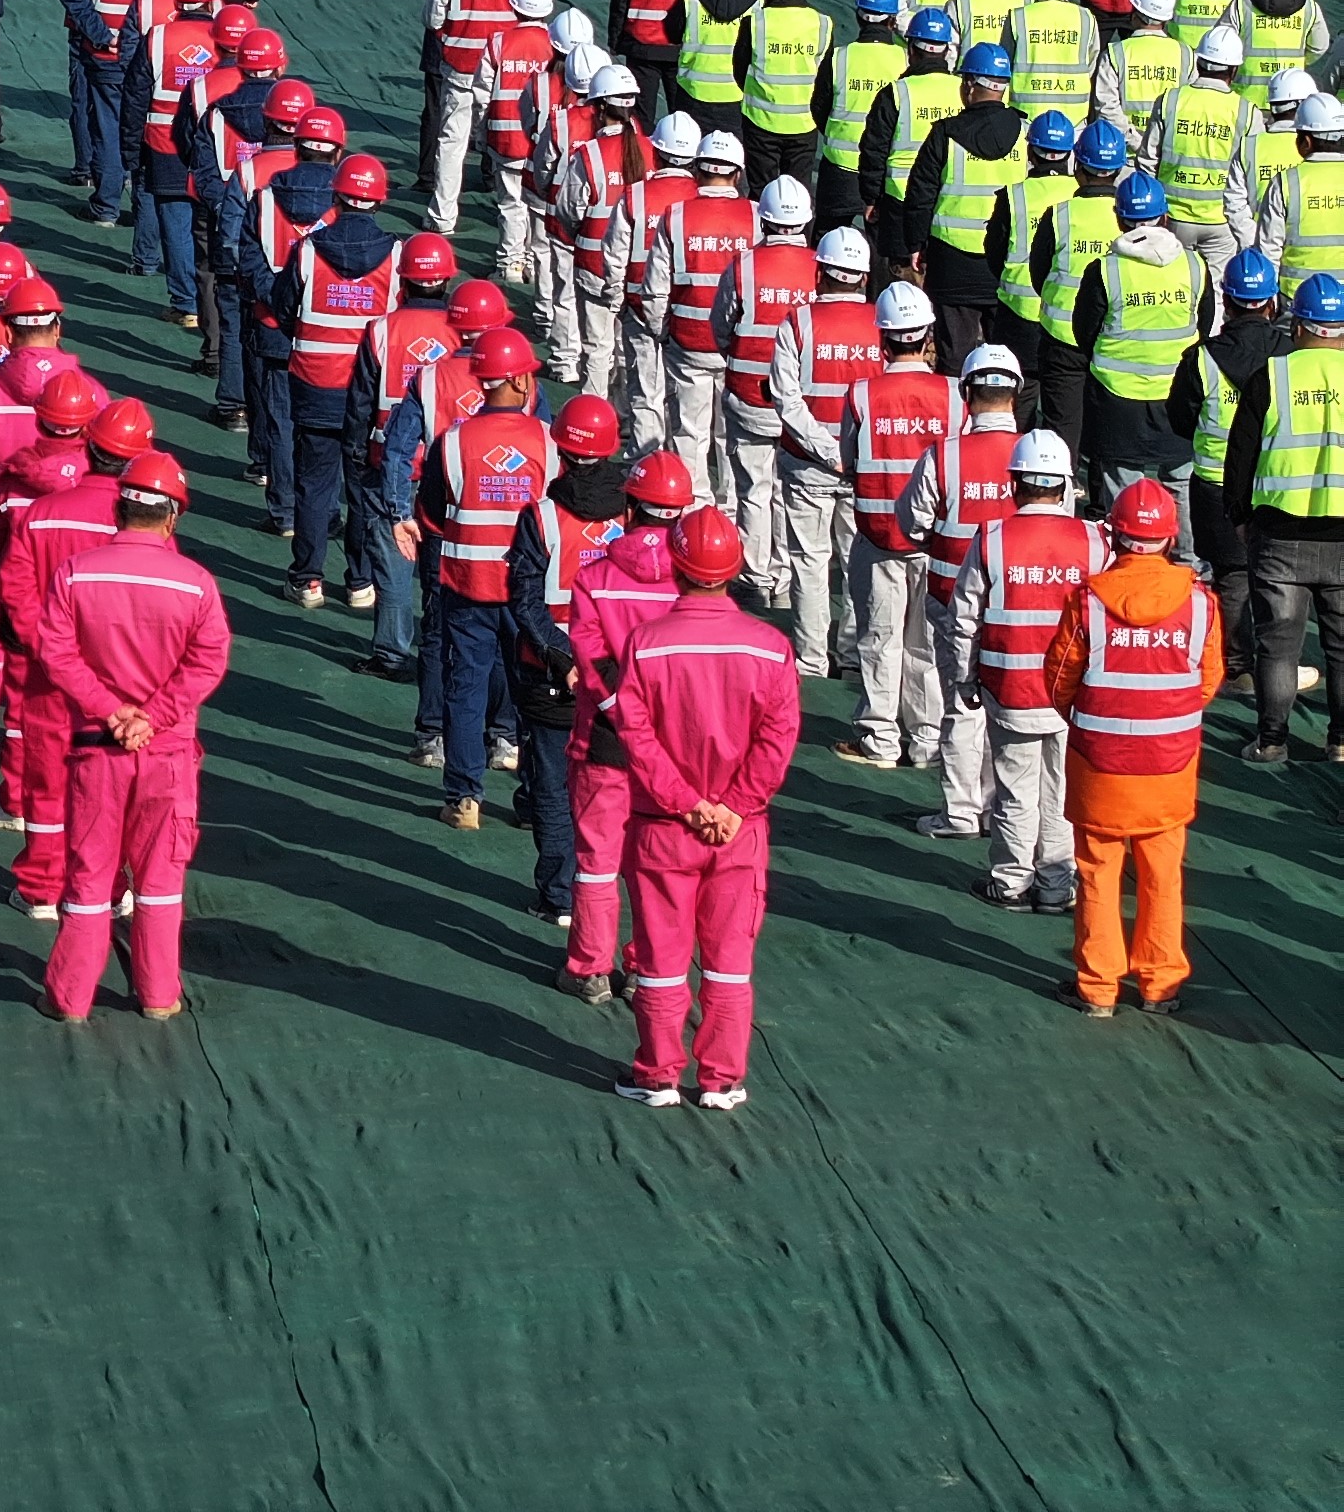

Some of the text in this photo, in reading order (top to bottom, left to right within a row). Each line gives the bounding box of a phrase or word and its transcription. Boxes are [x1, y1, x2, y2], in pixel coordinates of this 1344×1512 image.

[1028, 29, 1079, 45] 西北城建
[768, 42, 815, 56] 湖南火电
[1128, 64, 1178, 82] 西北城建
[1031, 78, 1076, 92] 管理人员
[1176, 118, 1231, 141] 西北城建
[1174, 170, 1229, 185] 施工人员
[688, 236, 749, 252] 湖南火电
[1126, 289, 1188, 307] 湖南火电
[816, 343, 881, 362] 湖南火电
[875, 417, 944, 436] 湖南火电
[1008, 566, 1082, 585] 湖南火电
[1111, 627, 1187, 649] 湖南火电
